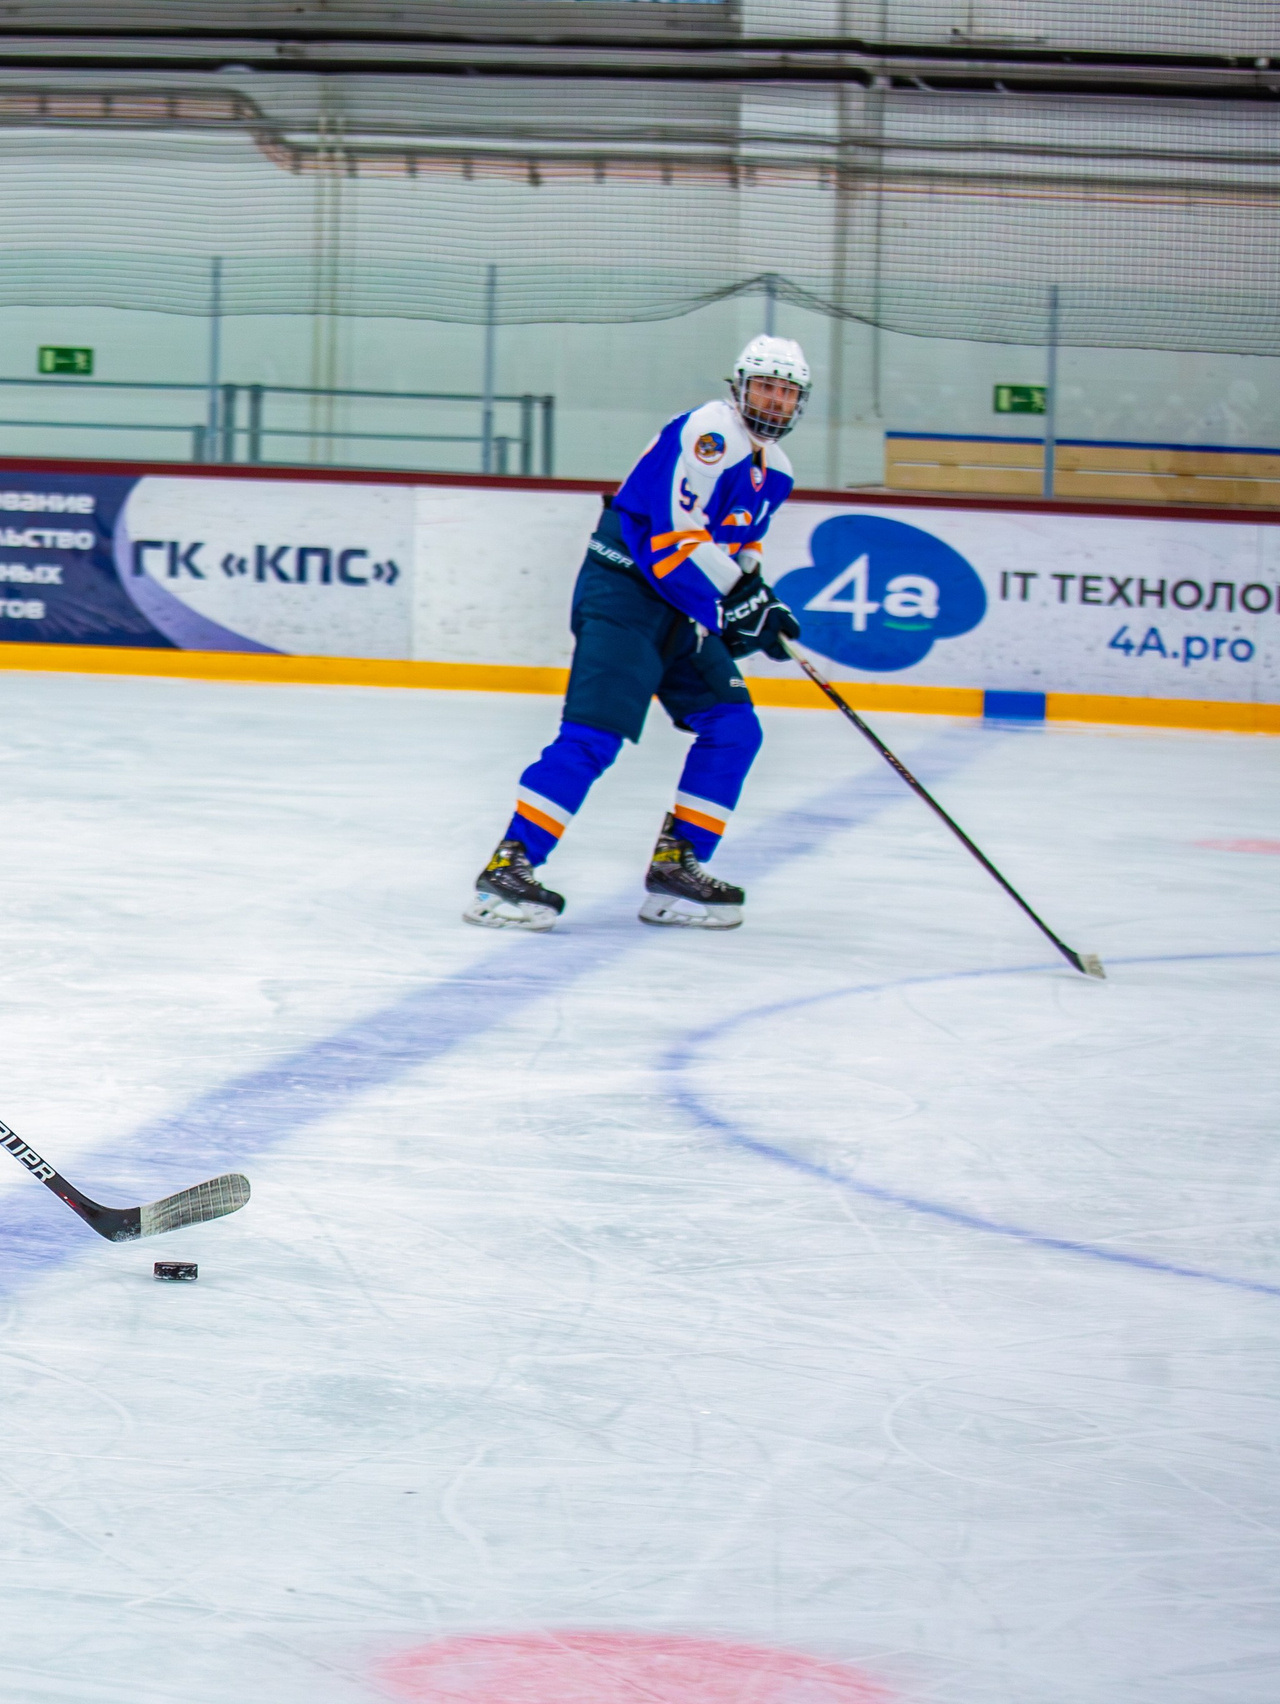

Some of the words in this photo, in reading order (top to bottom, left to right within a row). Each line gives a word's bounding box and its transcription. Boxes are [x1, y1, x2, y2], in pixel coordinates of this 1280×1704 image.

[131, 539, 206, 580] ГК
[221, 544, 400, 587] «КПС»
[802, 552, 941, 632] 4a
[1000, 571, 1038, 601] IT
[1050, 573, 1280, 615] ТЕХНОЛО
[1107, 625, 1256, 668] 4A.pro
